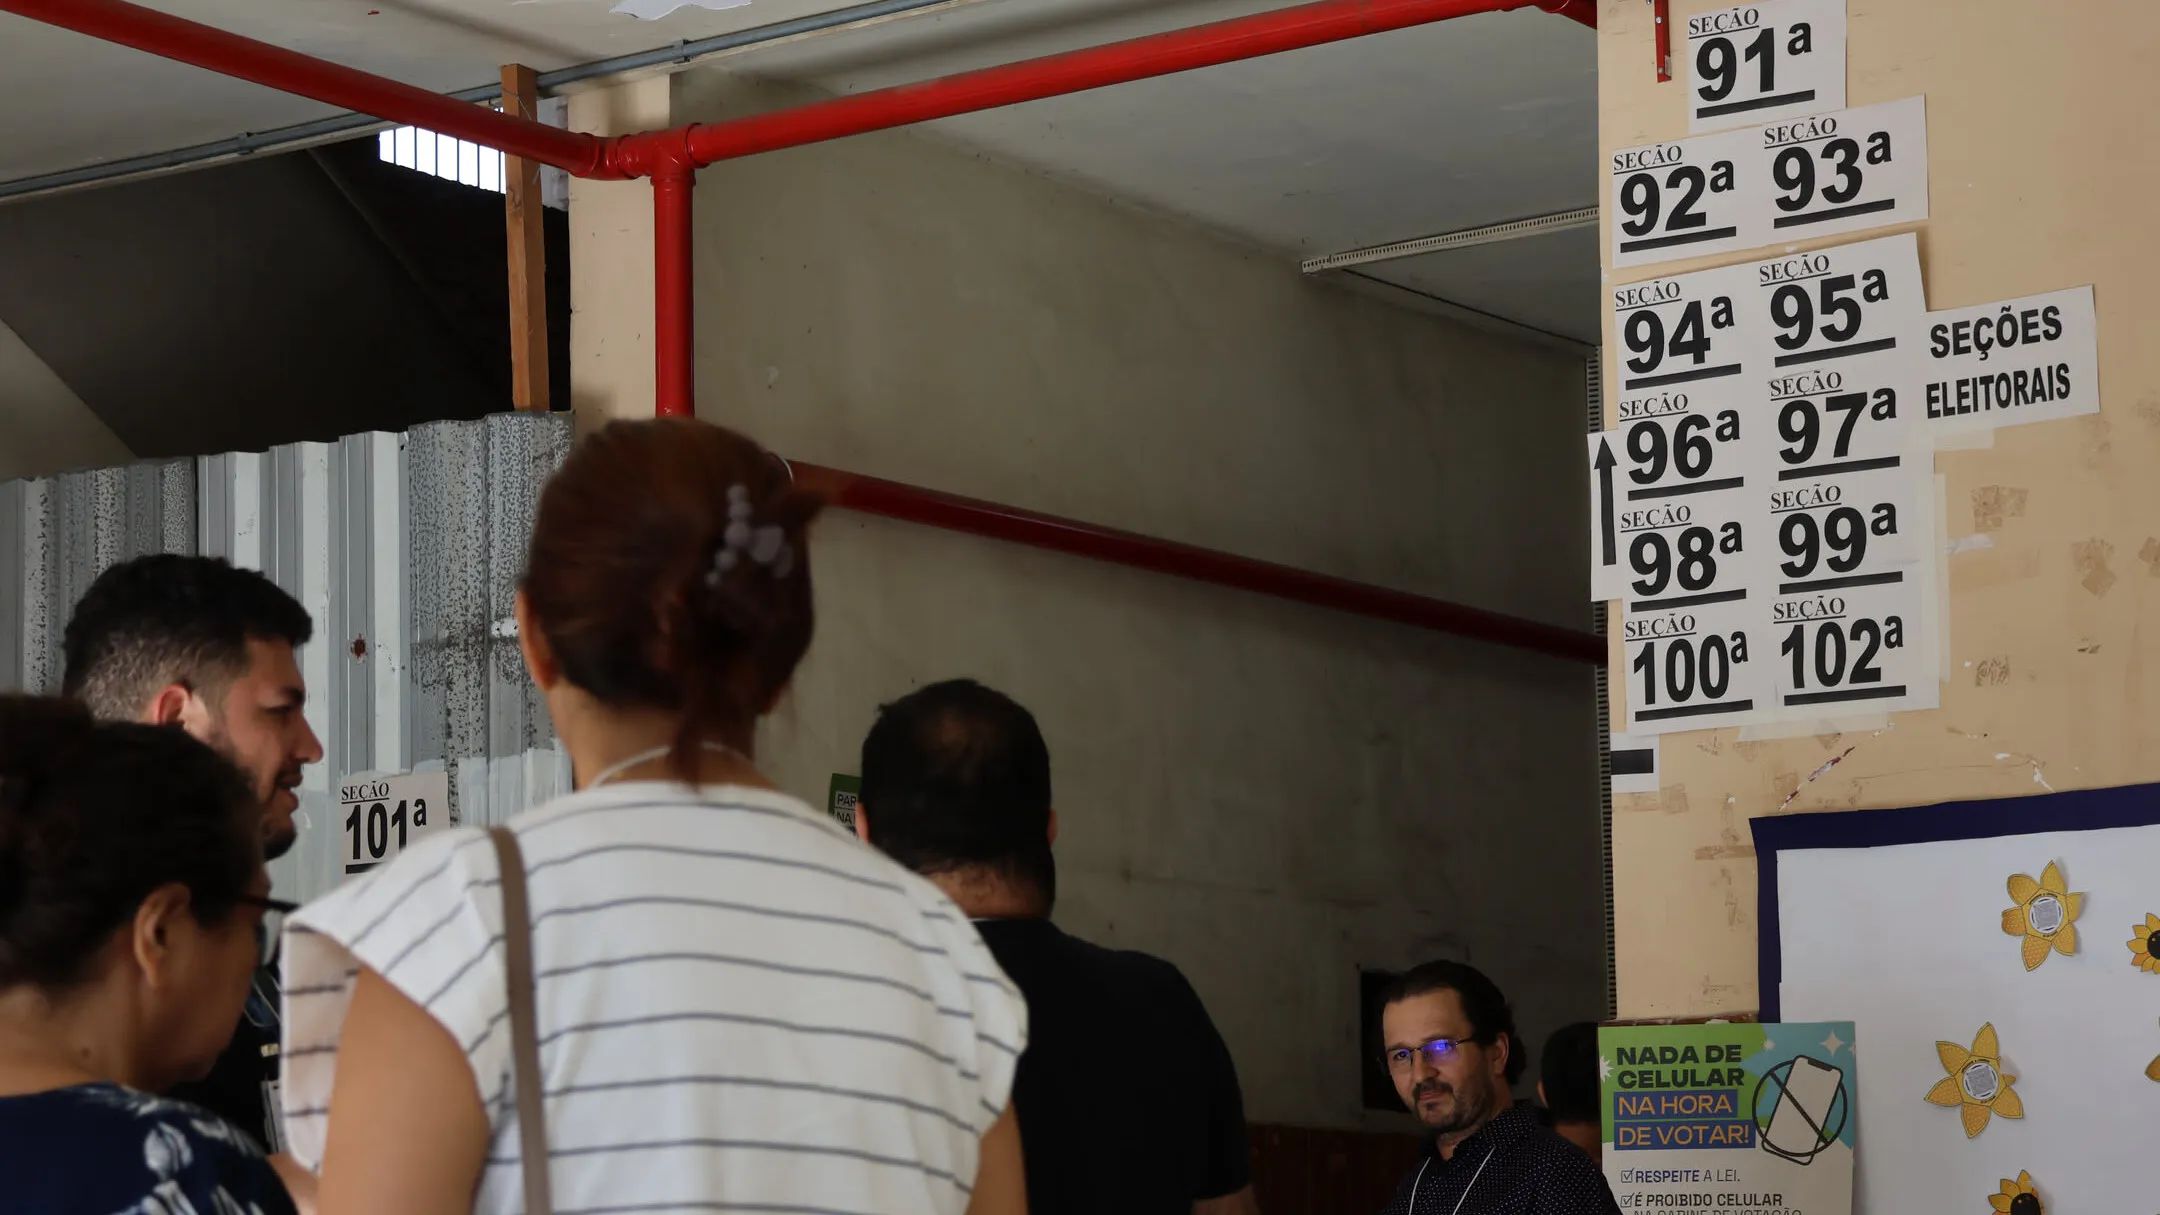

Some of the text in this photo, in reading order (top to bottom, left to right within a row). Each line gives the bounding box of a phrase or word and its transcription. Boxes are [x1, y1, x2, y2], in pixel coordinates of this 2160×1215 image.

[1688, 7, 1759, 36] SEÇÃO
[1764, 117, 1837, 145] SEÇÃO
[1613, 144, 1682, 171] SEÇÃO
[1760, 254, 1830, 282] SEÇÃO
[1615, 280, 1680, 306] SEÇÃO
[1929, 305, 2062, 360] SEÇÕES
[1770, 370, 1842, 398] SEÇÃO
[1926, 362, 2071, 420] ELEITORAIS
[1619, 393, 1688, 419] SEÇÃO
[1771, 484, 1841, 511] SEÇÃO
[1621, 504, 1691, 530] SEÇÃO
[1773, 597, 1845, 621] SEÇÃO
[1625, 614, 1696, 639] SEÇÃO
[341, 781, 390, 800] SEÇÃO
[1616, 1044, 1742, 1066] NADA DE
[1617, 1068, 1745, 1089] CELULAR
[1618, 1094, 1733, 1116] NA HORA
[1619, 1124, 1749, 1146] DE VOTAR!
[1635, 1170, 1741, 1183] RESPEITE A LEI.
[1634, 1192, 1783, 1207] É PROIBIDO CELULAR
